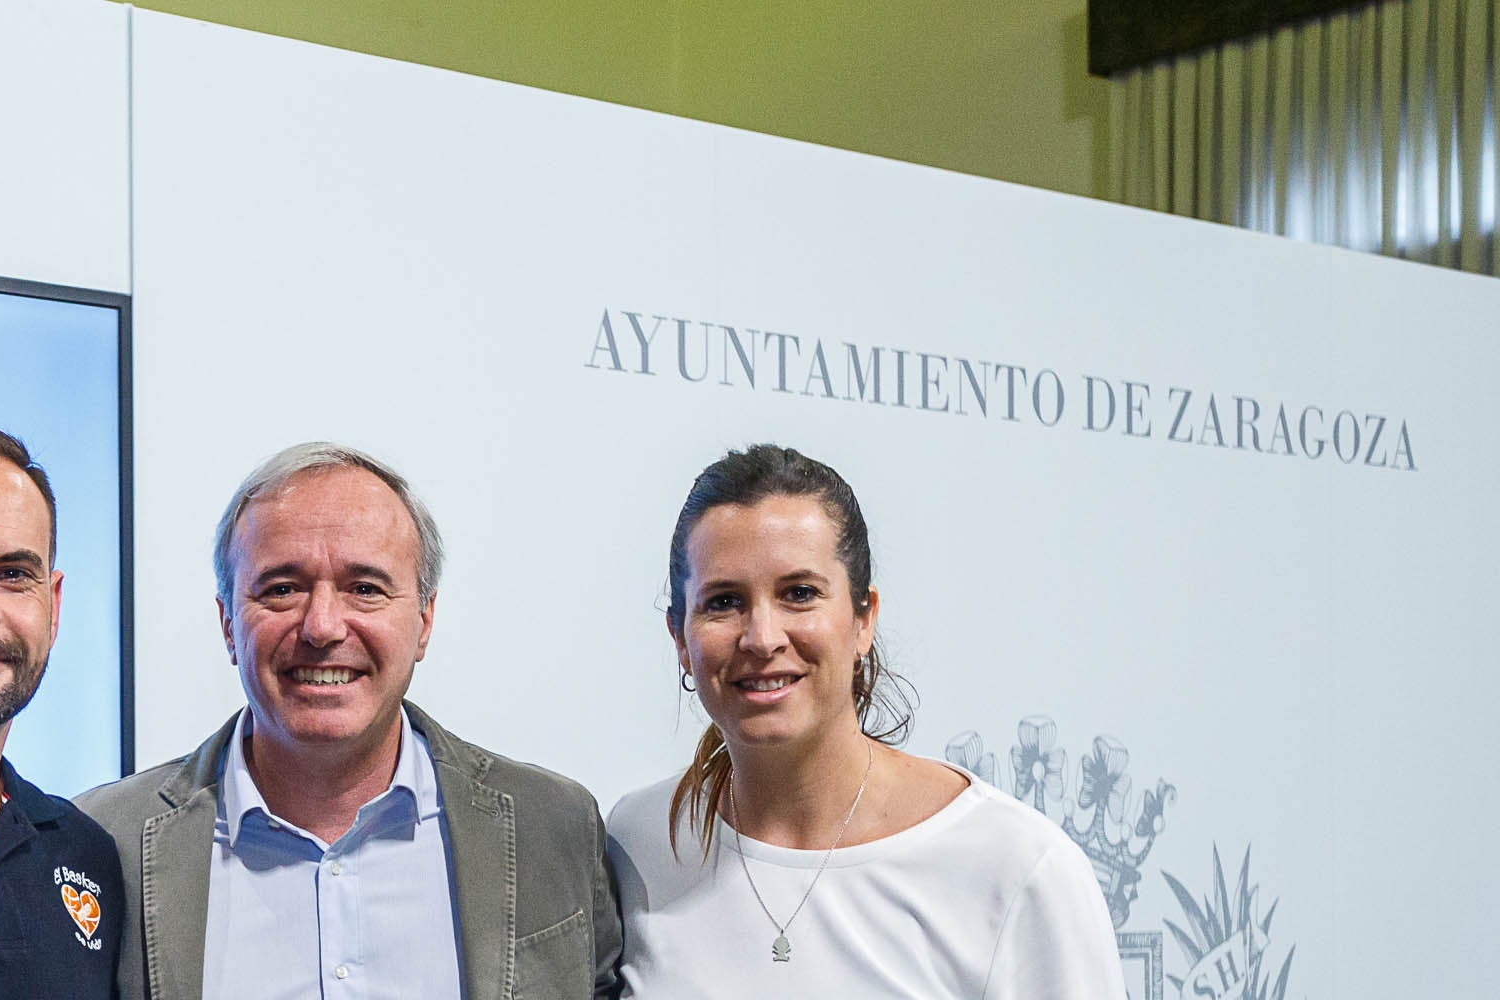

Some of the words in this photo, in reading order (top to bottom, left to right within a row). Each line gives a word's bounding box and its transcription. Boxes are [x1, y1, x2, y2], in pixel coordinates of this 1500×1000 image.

[583, 307, 1066, 427] AYUNTAMIENTO
[1081, 376, 1152, 438] DE
[1167, 388, 1419, 472] ZARAGOZA
